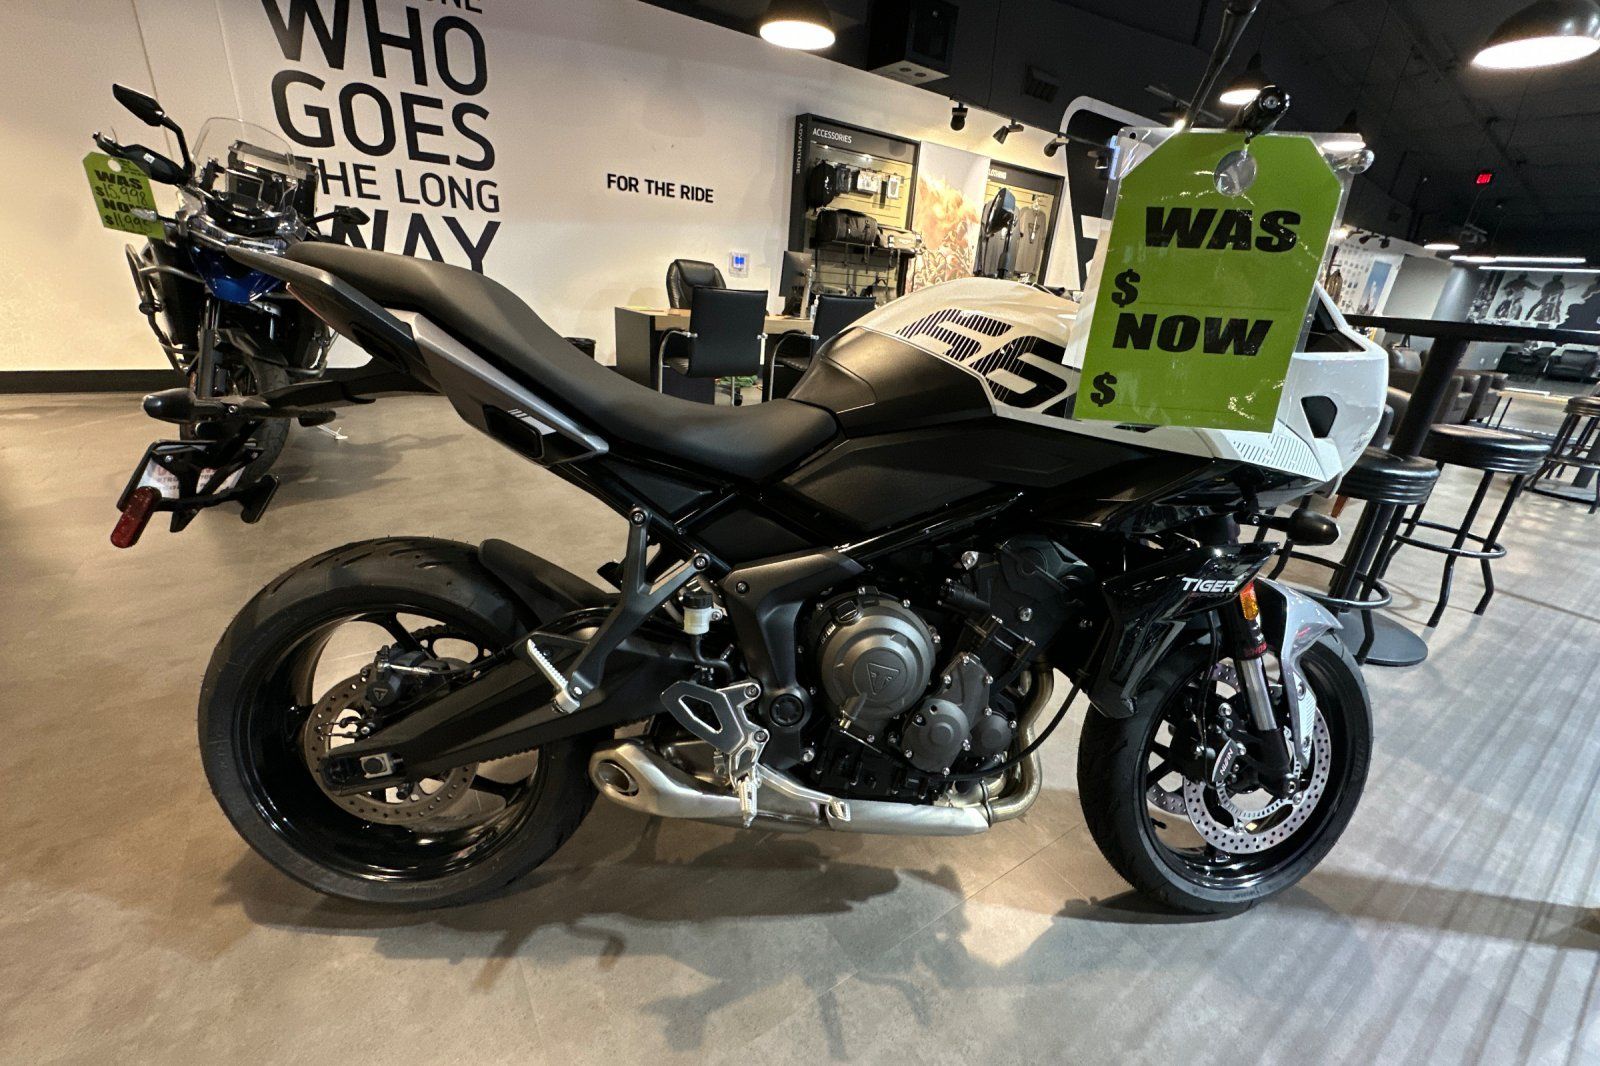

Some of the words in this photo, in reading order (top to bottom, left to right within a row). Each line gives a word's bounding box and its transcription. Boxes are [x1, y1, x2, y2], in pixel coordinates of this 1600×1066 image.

[260, 0, 488, 95] WHO
[271, 69, 496, 171] GOES
[813, 128, 852, 143] ACCESSORIES
[796, 123, 804, 174] ADVENTURE
[94, 169, 143, 190] WAS
[294, 155, 381, 200] HE
[395, 169, 500, 213] LONG
[607, 173, 639, 193] FOR
[644, 179, 675, 198] THE
[680, 184, 714, 203] RIDE
[1145, 206, 1301, 253] WAS
[1111, 268, 1141, 308] $
[1112, 312, 1274, 357] NOW
[1090, 372, 1118, 407] $
[1181, 577, 1239, 593] TIGER
